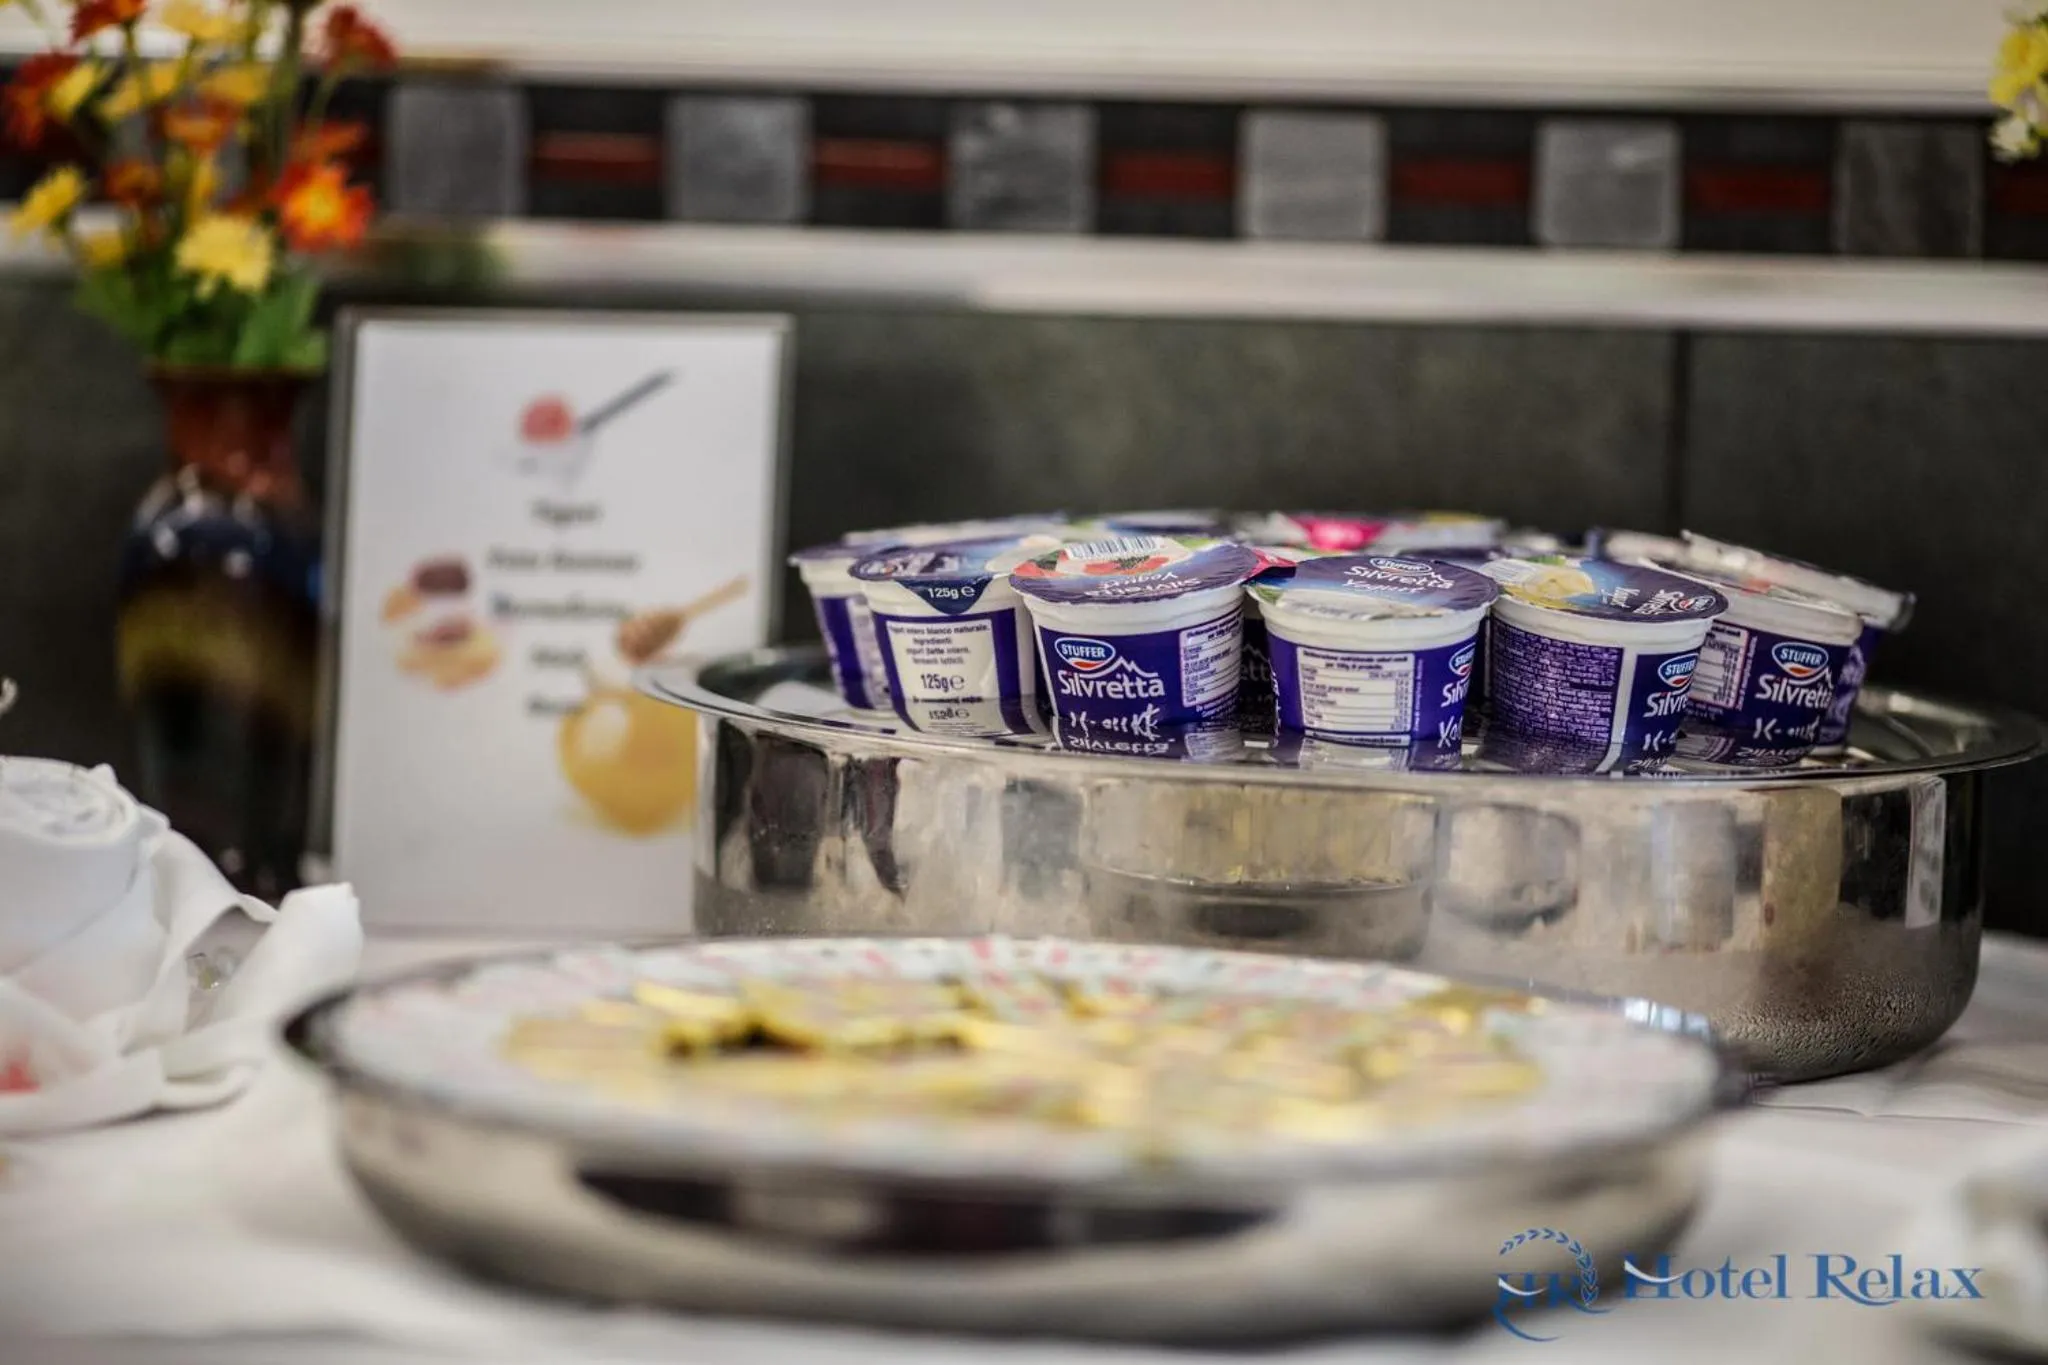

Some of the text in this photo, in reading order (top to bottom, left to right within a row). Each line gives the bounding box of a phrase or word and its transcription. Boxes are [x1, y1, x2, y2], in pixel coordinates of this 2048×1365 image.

[1344, 566, 1454, 589] Silvretta
[928, 587, 959, 599] 125g
[1060, 643, 1105, 658] STUFFER
[1780, 647, 1822, 665] STUFFER
[920, 674, 949, 693] 125g
[1057, 669, 1165, 699] Silvretta
